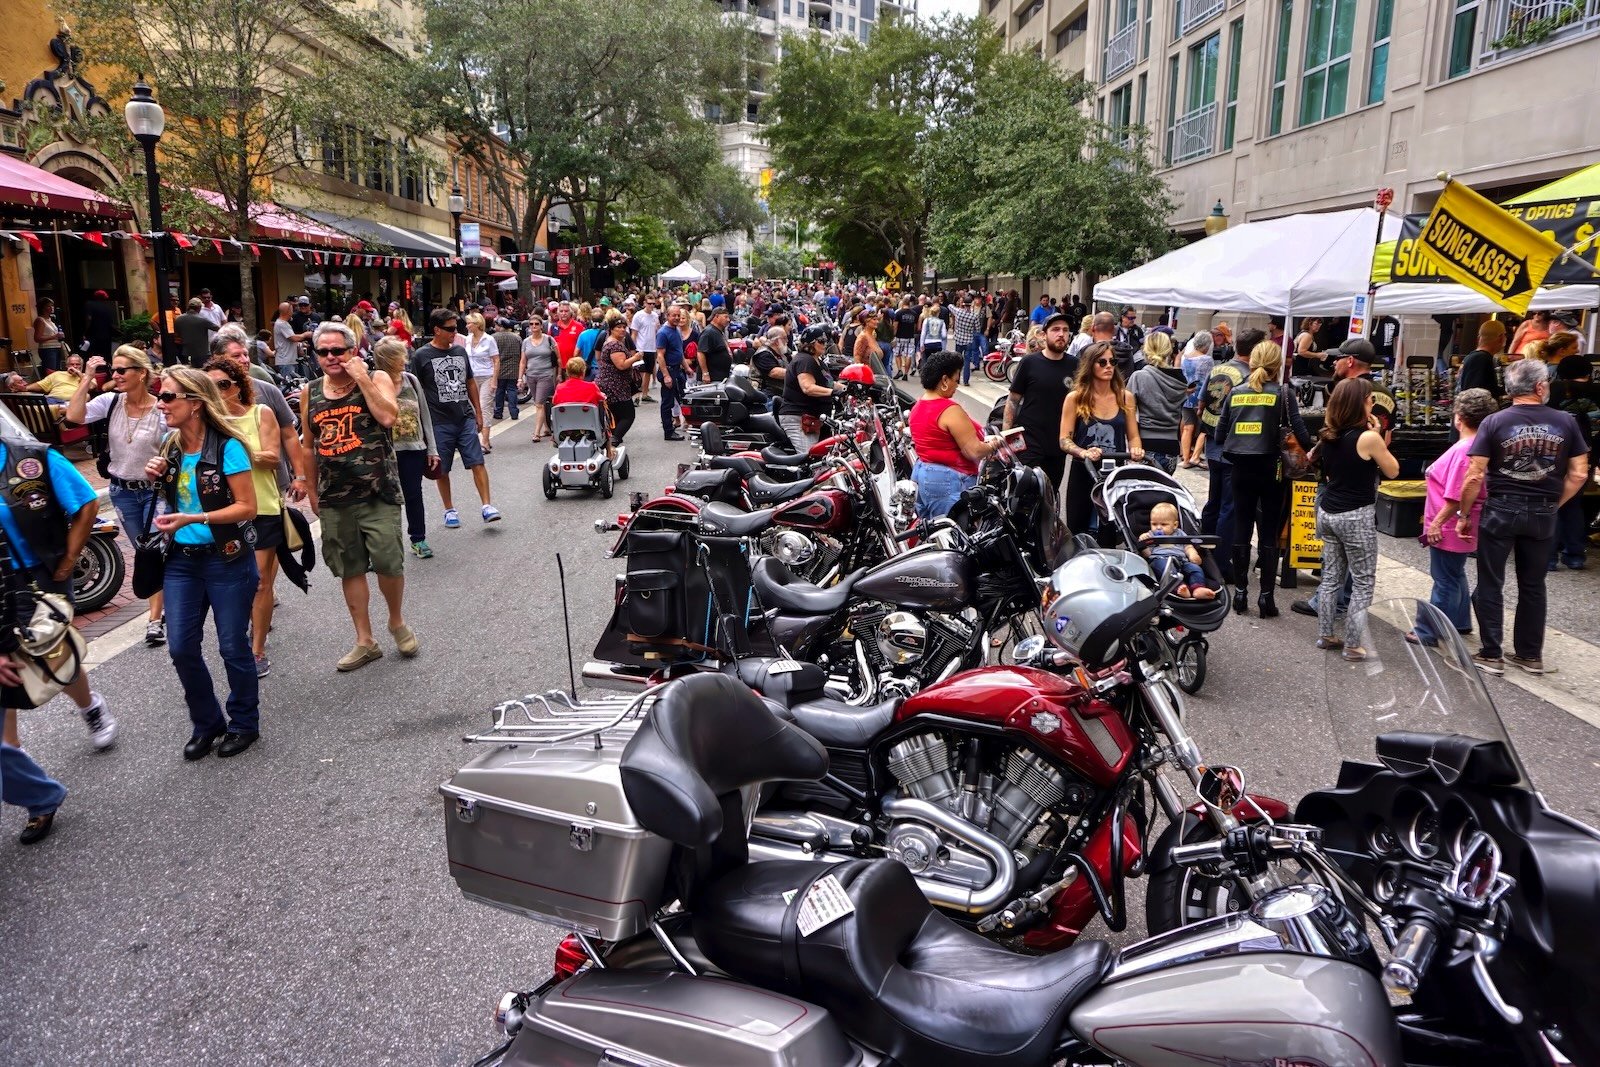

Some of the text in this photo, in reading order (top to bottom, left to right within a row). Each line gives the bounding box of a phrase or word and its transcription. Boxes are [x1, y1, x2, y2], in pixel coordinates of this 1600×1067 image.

[1525, 203, 1577, 221] OPTICS
[1429, 213, 1522, 292] SUNGLASSES
[319, 413, 357, 446] 81
[1237, 424, 1261, 432] LADIES
